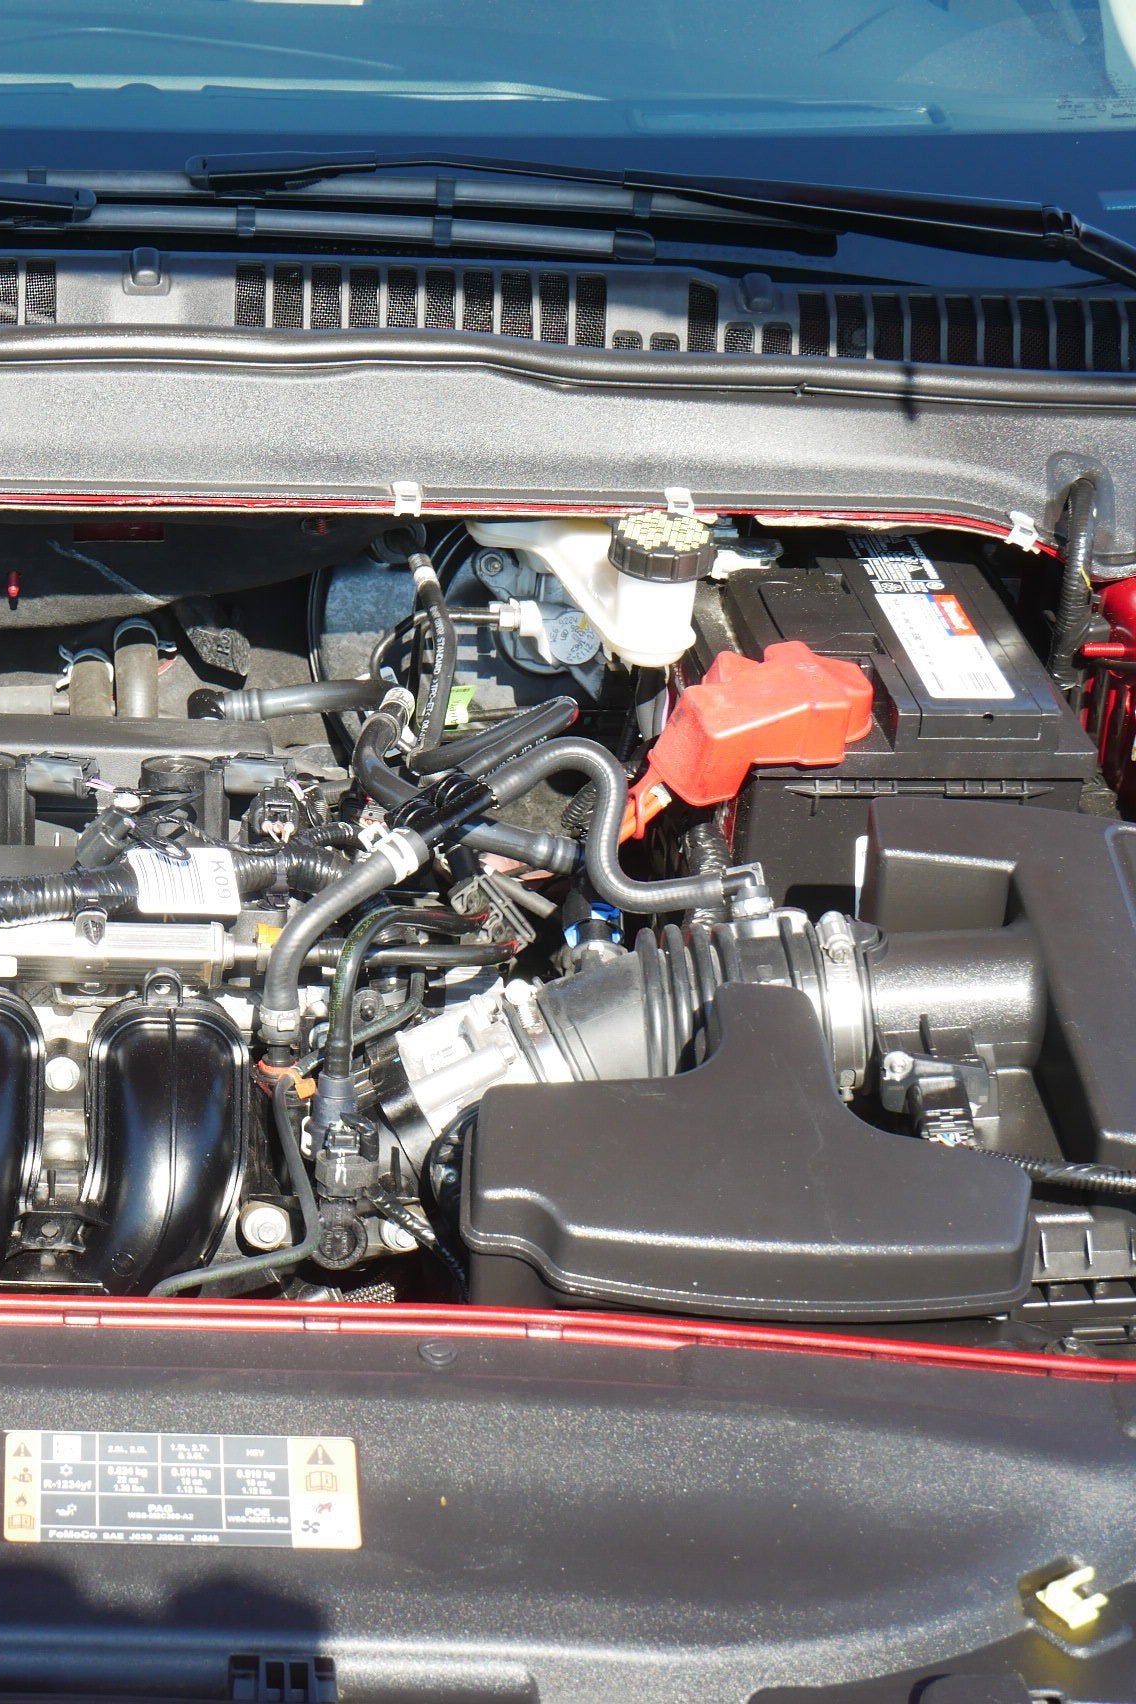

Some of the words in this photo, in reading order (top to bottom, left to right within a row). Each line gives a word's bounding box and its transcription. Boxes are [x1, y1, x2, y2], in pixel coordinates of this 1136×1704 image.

[433, 636, 446, 675] STANDARD
[135, 1465, 148, 1478] kg
[198, 1467, 212, 1480] kg
[263, 1469, 276, 1481] kg
[43, 1479, 92, 1491] R-1234yf
[147, 1503, 174, 1512] PAG
[48, 1529, 98, 1540] FoMoCo
[102, 1531, 125, 1540] SAE
